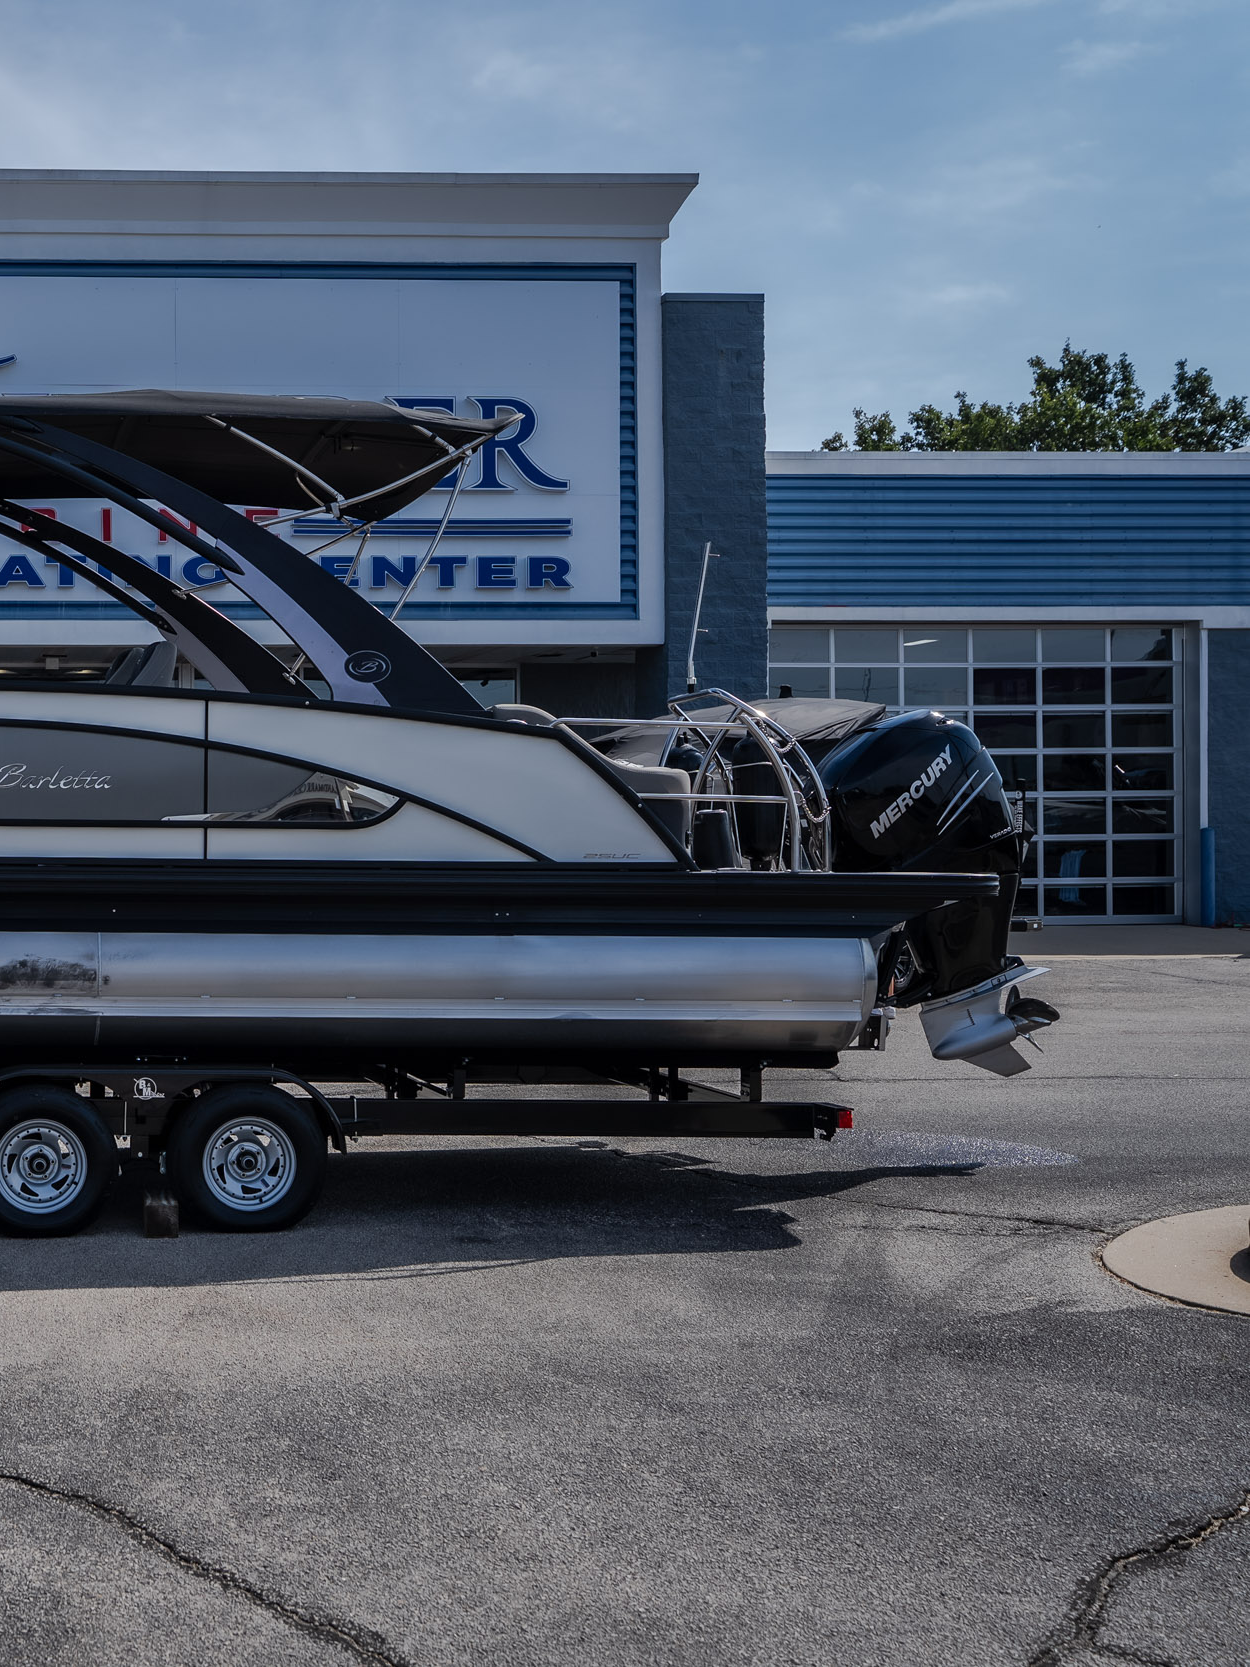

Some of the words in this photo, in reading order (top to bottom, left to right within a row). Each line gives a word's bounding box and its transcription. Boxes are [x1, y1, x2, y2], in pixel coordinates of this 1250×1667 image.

[320, 555, 574, 589] ENTER
[869, 743, 953, 839] MERCURY
[989, 826, 1012, 839] VERADO
